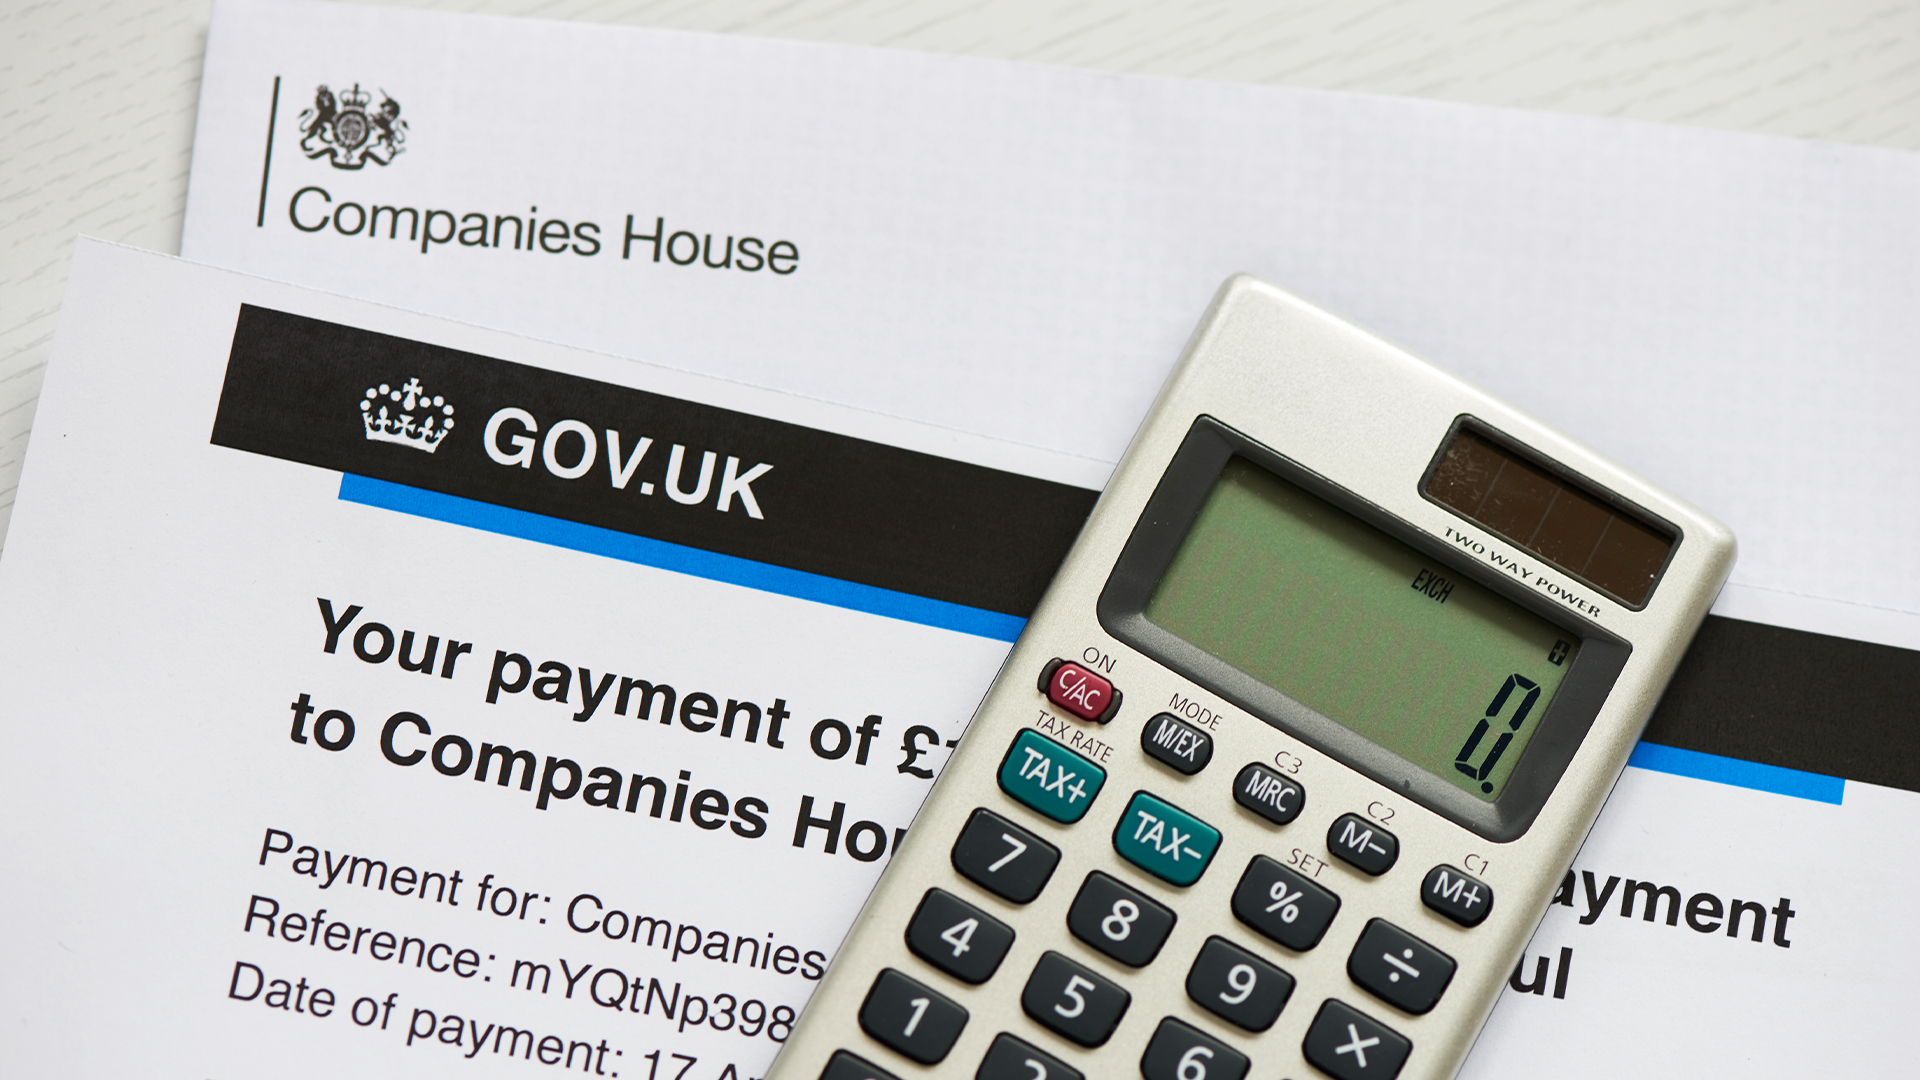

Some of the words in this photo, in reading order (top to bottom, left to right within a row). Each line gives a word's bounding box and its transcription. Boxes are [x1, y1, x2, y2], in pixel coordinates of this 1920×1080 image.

[289, 186, 601, 256] Companies
[622, 214, 799, 275] House
[483, 407, 774, 520] GOV.UK
[1411, 568, 1454, 604] EXCH
[1445, 526, 1485, 554] TWO
[1490, 551, 1533, 579] WAY
[1536, 576, 1601, 618] POWER
[316, 597, 473, 680] Your
[485, 649, 791, 750] payment
[809, 714, 883, 766] of
[1082, 646, 1117, 674] ON
[1059, 669, 1101, 711] C/AC
[1168, 692, 1224, 732] MODE
[1036, 710, 1071, 741] TAX
[1070, 729, 1115, 764] RATE
[1152, 719, 1205, 763] M/EX
[290, 692, 356, 752] to
[379, 711, 769, 839] Companies
[1018, 746, 1088, 804] TAX+
[1274, 750, 1303, 775] C3
[1245, 770, 1297, 812] MRC
[1367, 801, 1396, 826] C2
[987, 832, 1028, 873] 7
[1133, 810, 1203, 863] TAX-
[1287, 848, 1330, 878] SET
[1464, 853, 1490, 876] C1
[258, 827, 464, 907] Payment
[477, 874, 551, 925] for:
[567, 893, 828, 981] Companies
[1265, 880, 1304, 924] %
[1432, 869, 1482, 909] M+
[940, 917, 979, 958] 4
[1101, 898, 1141, 942] 8
[244, 894, 496, 982] Reference:
[510, 958, 797, 1045] mYQtNp398
[1219, 963, 1258, 1005] 9
[903, 996, 931, 1038] 1
[1053, 974, 1096, 1018] 5
[228, 961, 336, 1018] Date
[351, 992, 399, 1030] of
[406, 1008, 623, 1078] payment:
[1176, 1045, 1215, 1080] 6
